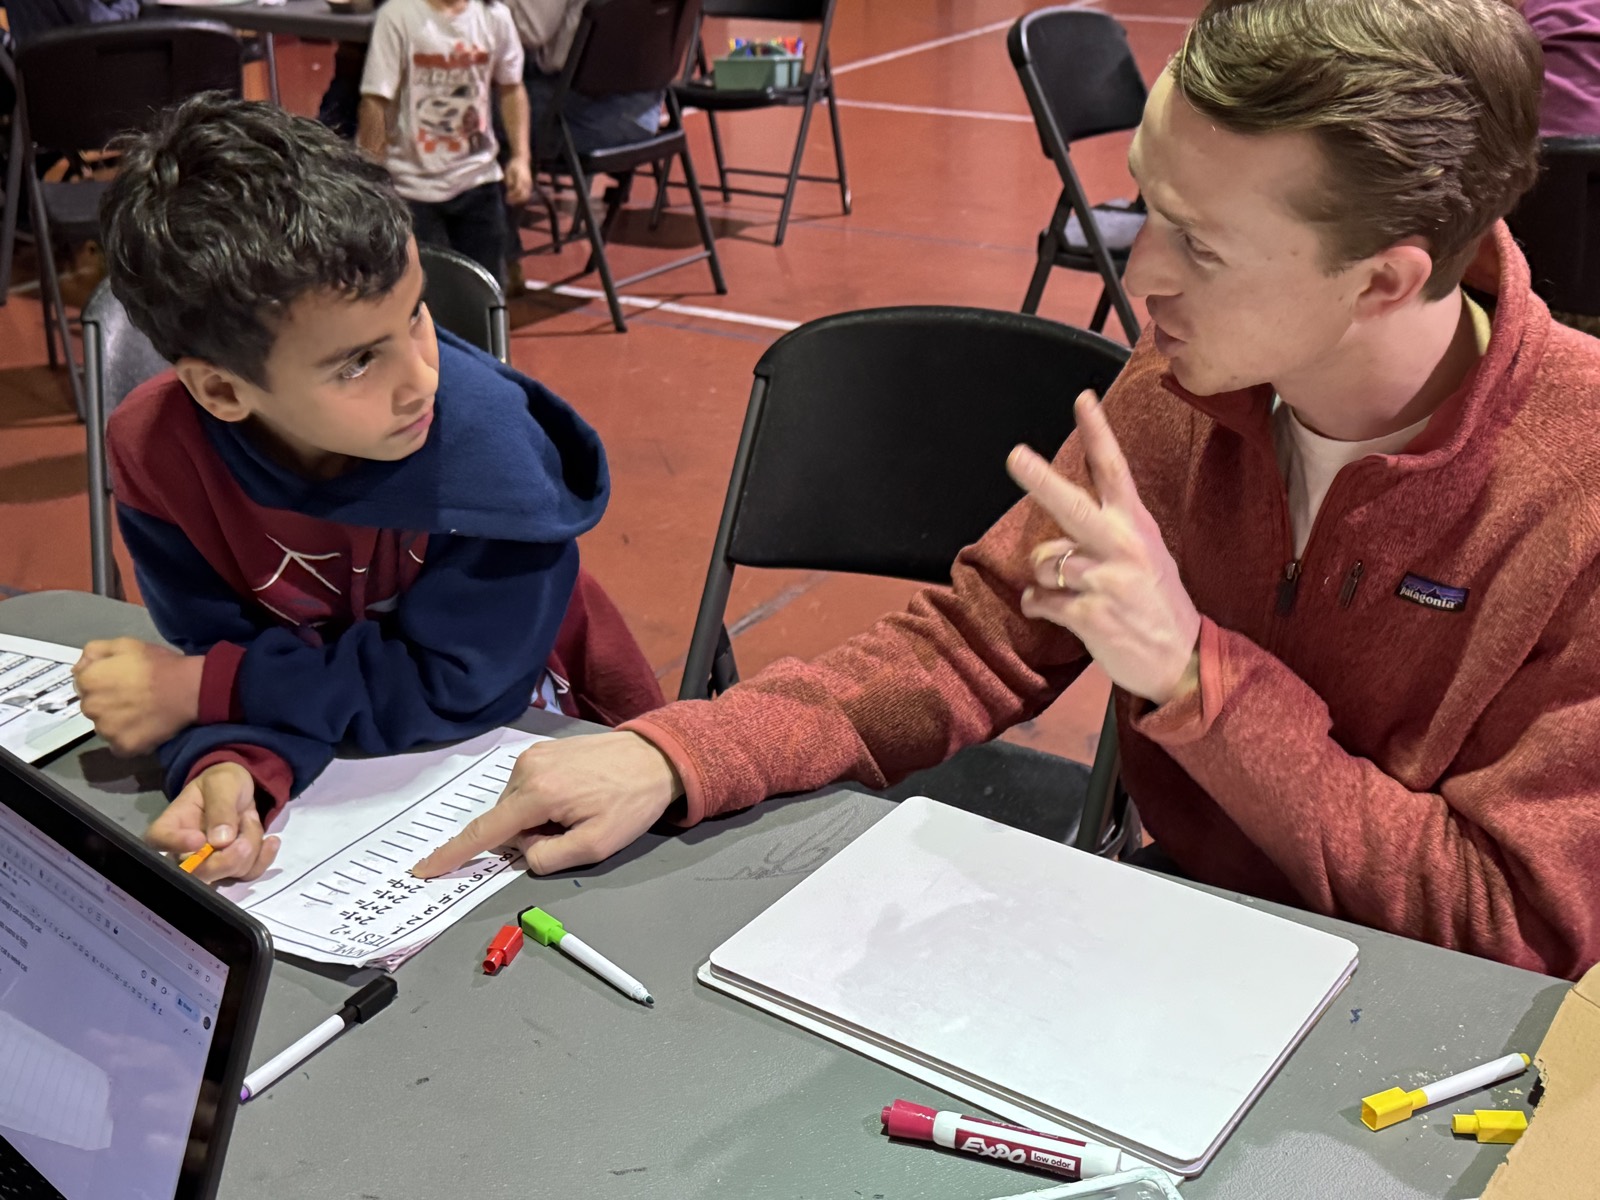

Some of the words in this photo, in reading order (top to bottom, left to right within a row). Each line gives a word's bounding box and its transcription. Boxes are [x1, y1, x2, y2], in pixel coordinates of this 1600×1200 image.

[1399, 586, 1455, 609] patagonia
[373, 889, 409, 904] 2+1=
[354, 899, 393, 914] 2+7=
[339, 910, 376, 925] 2+1=
[329, 924, 351, 935] +2
[347, 931, 390, 947] TEST
[960, 1136, 1027, 1164] EXPO
[1034, 1152, 1049, 1163] low
[1051, 1157, 1071, 1168] odor
